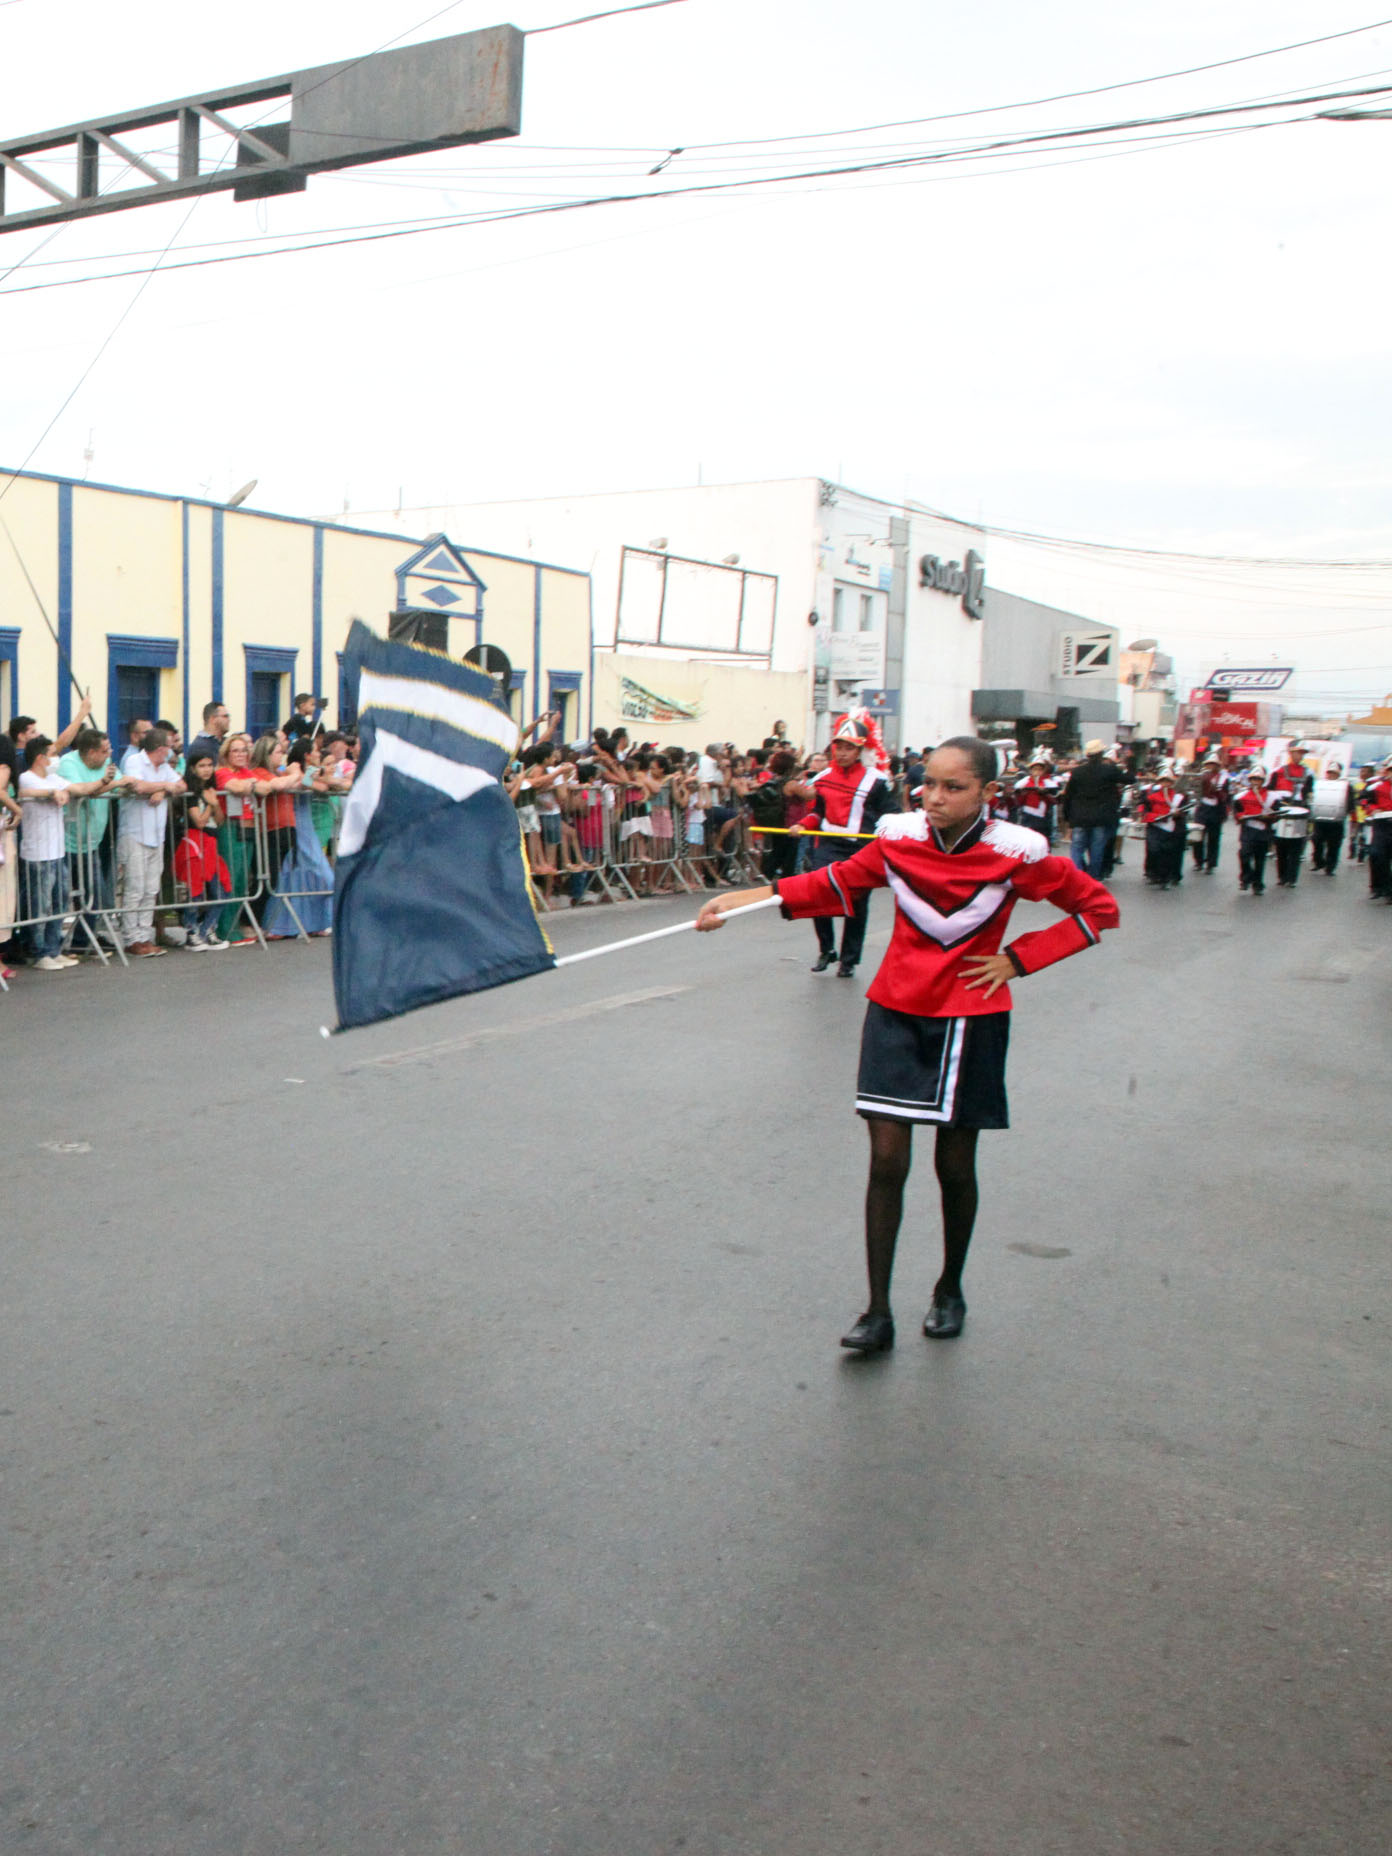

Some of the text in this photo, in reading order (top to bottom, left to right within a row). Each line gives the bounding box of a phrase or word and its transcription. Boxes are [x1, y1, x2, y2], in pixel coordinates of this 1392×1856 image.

[918, 553, 970, 597] Studio
[1062, 633, 1113, 676] STUDIO Z
